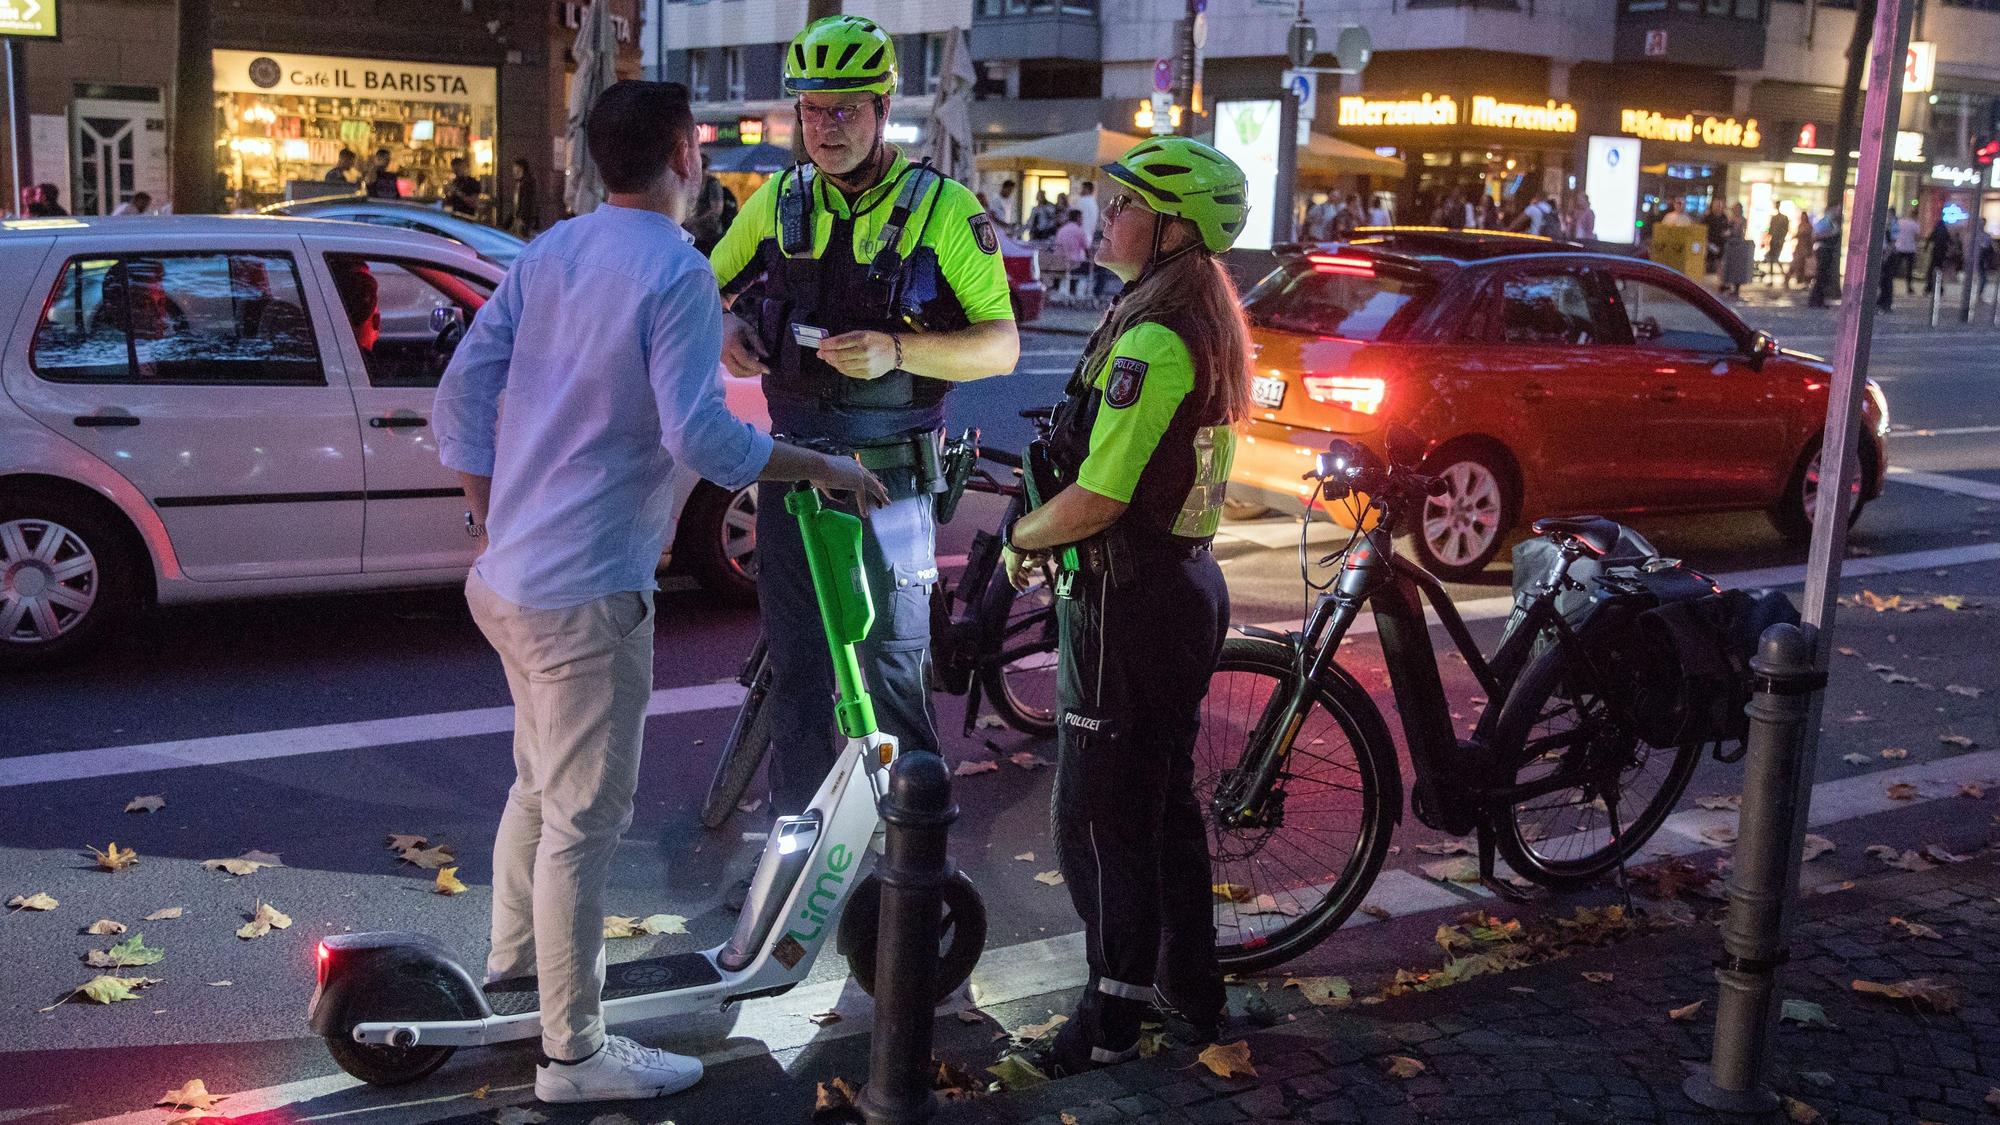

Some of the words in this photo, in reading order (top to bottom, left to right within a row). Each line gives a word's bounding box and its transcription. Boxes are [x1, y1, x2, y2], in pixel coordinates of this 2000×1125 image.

[290, 71, 330, 88] Café
[334, 69, 356, 88] IL
[364, 71, 469, 95] BARISTA
[1114, 359, 1147, 374] POLIZEI
[1064, 711, 1101, 732] POLIZEI
[788, 842, 853, 942] Lime
